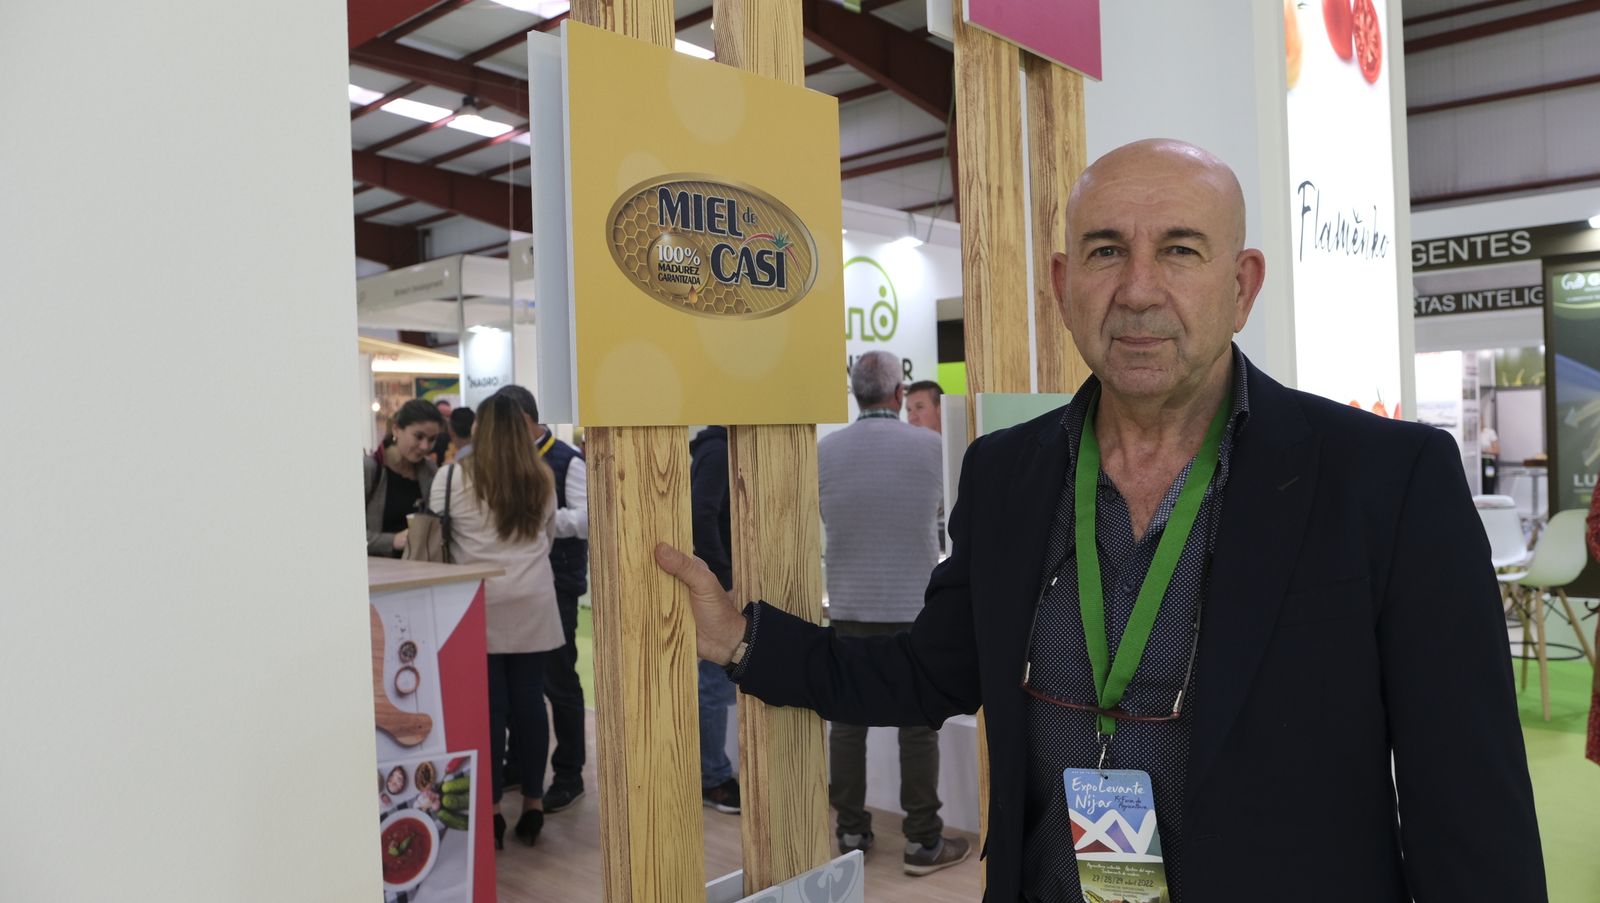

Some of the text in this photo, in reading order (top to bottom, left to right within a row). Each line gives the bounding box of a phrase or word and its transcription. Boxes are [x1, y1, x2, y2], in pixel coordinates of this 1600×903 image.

[657, 186, 757, 238] MIEL de
[657, 244, 701, 266] 100%
[1412, 230, 1532, 267] GENTES
[657, 263, 700, 276] MADUREZ
[710, 242, 787, 290] CASI
[657, 274, 701, 286] GARANTIZADA
[1461, 286, 1544, 311] INTELIG
[1075, 795, 1112, 815] Níjar
